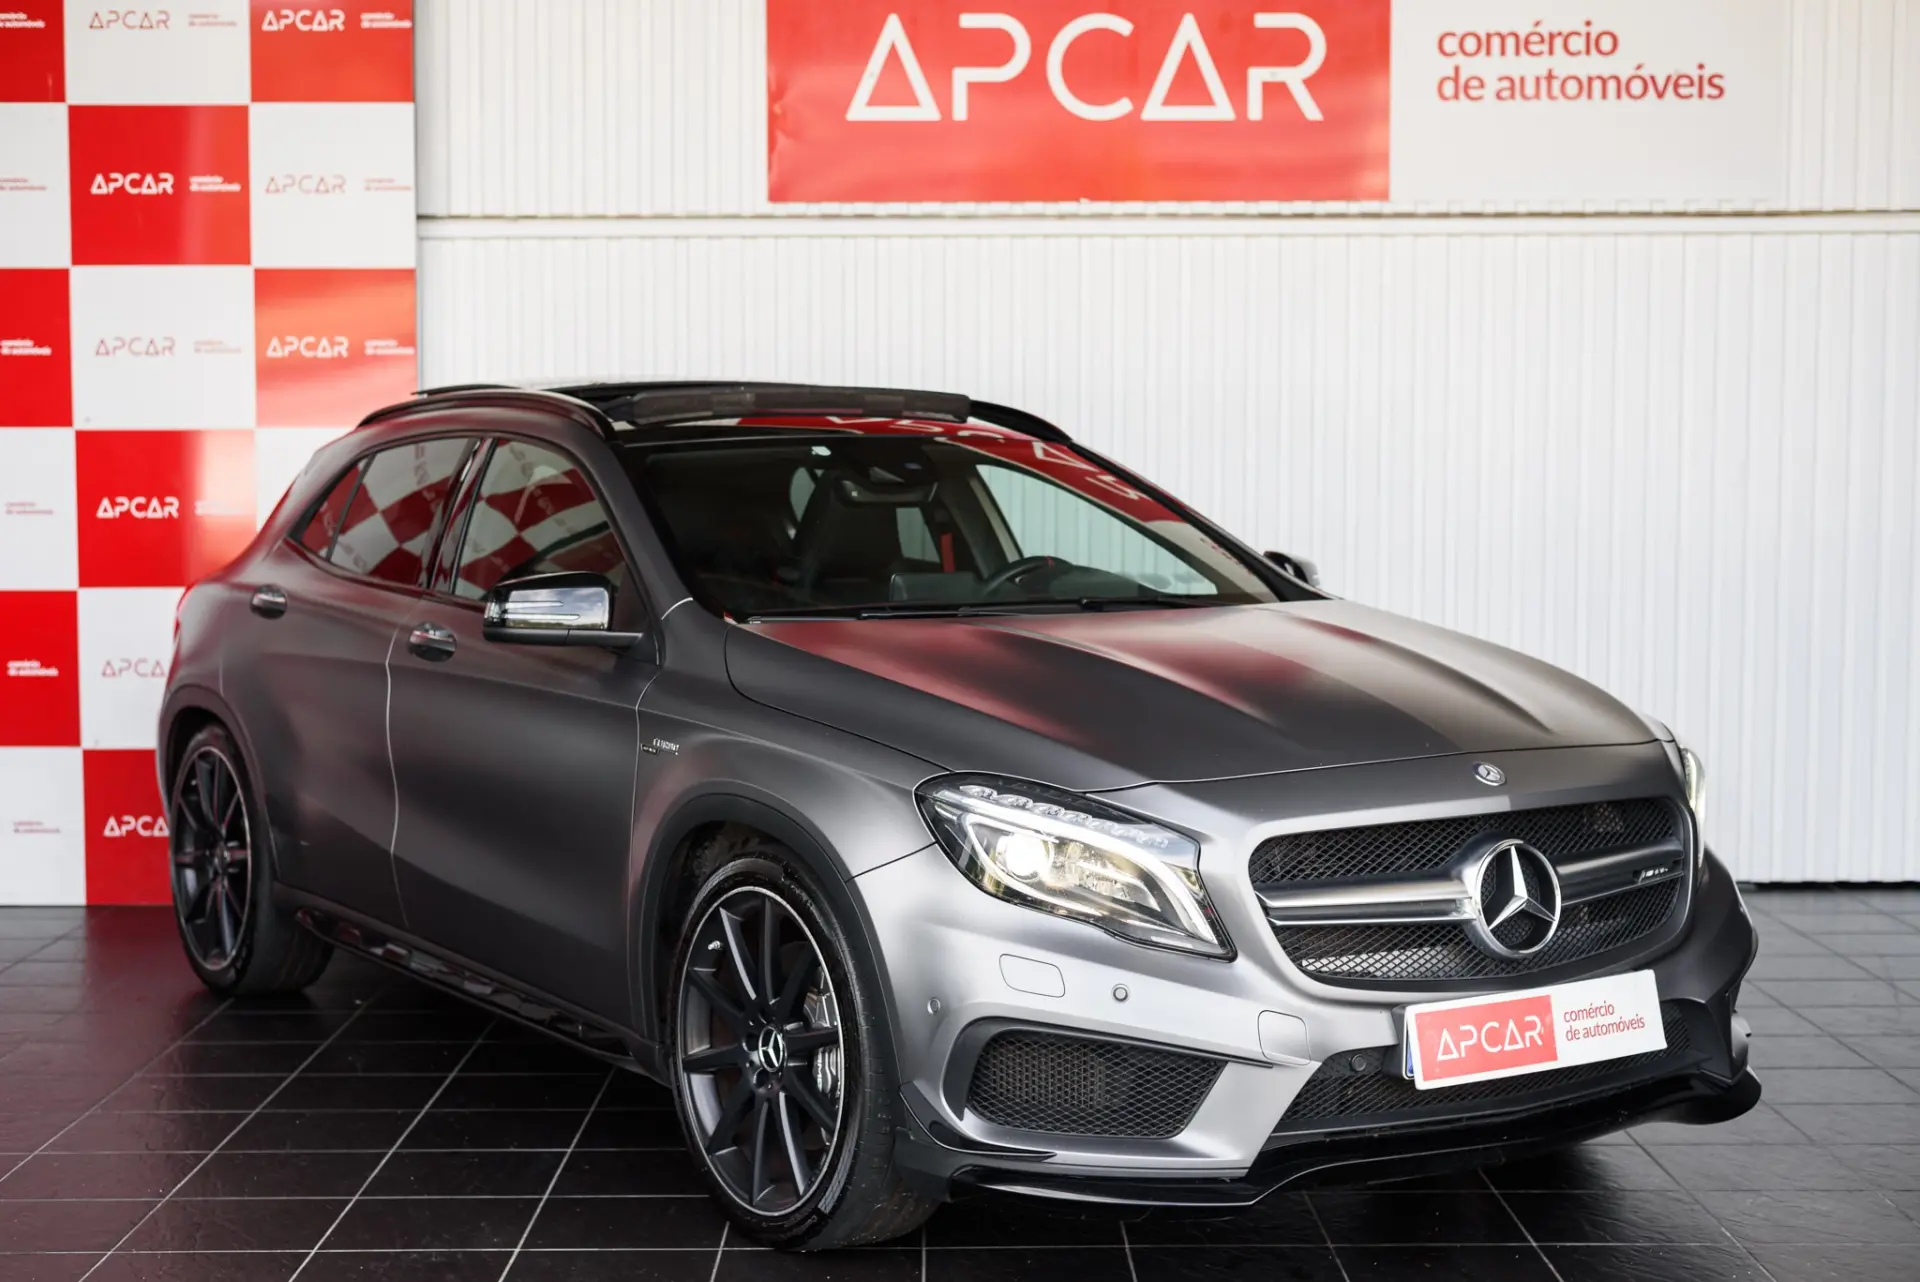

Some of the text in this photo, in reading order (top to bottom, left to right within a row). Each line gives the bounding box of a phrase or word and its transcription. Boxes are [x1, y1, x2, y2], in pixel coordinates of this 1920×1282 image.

[88, 10, 170, 30] APCAR
[261, 9, 345, 31] APCAR
[1437, 20, 1619, 57] comércio
[845, 13, 1327, 121] APCAR
[1437, 63, 1725, 101] de automóveis
[90, 172, 174, 195] APCAR
[265, 174, 347, 194] APCAR
[95, 336, 176, 356] APCAR
[266, 336, 349, 358] APCAR
[96, 496, 180, 519] APCAR
[101, 659, 166, 678] APCA
[103, 815, 170, 837] APCA
[1563, 1000, 1615, 1023] comércio
[1437, 1015, 1543, 1060] APCAR
[1565, 1013, 1646, 1041] de automóveis
